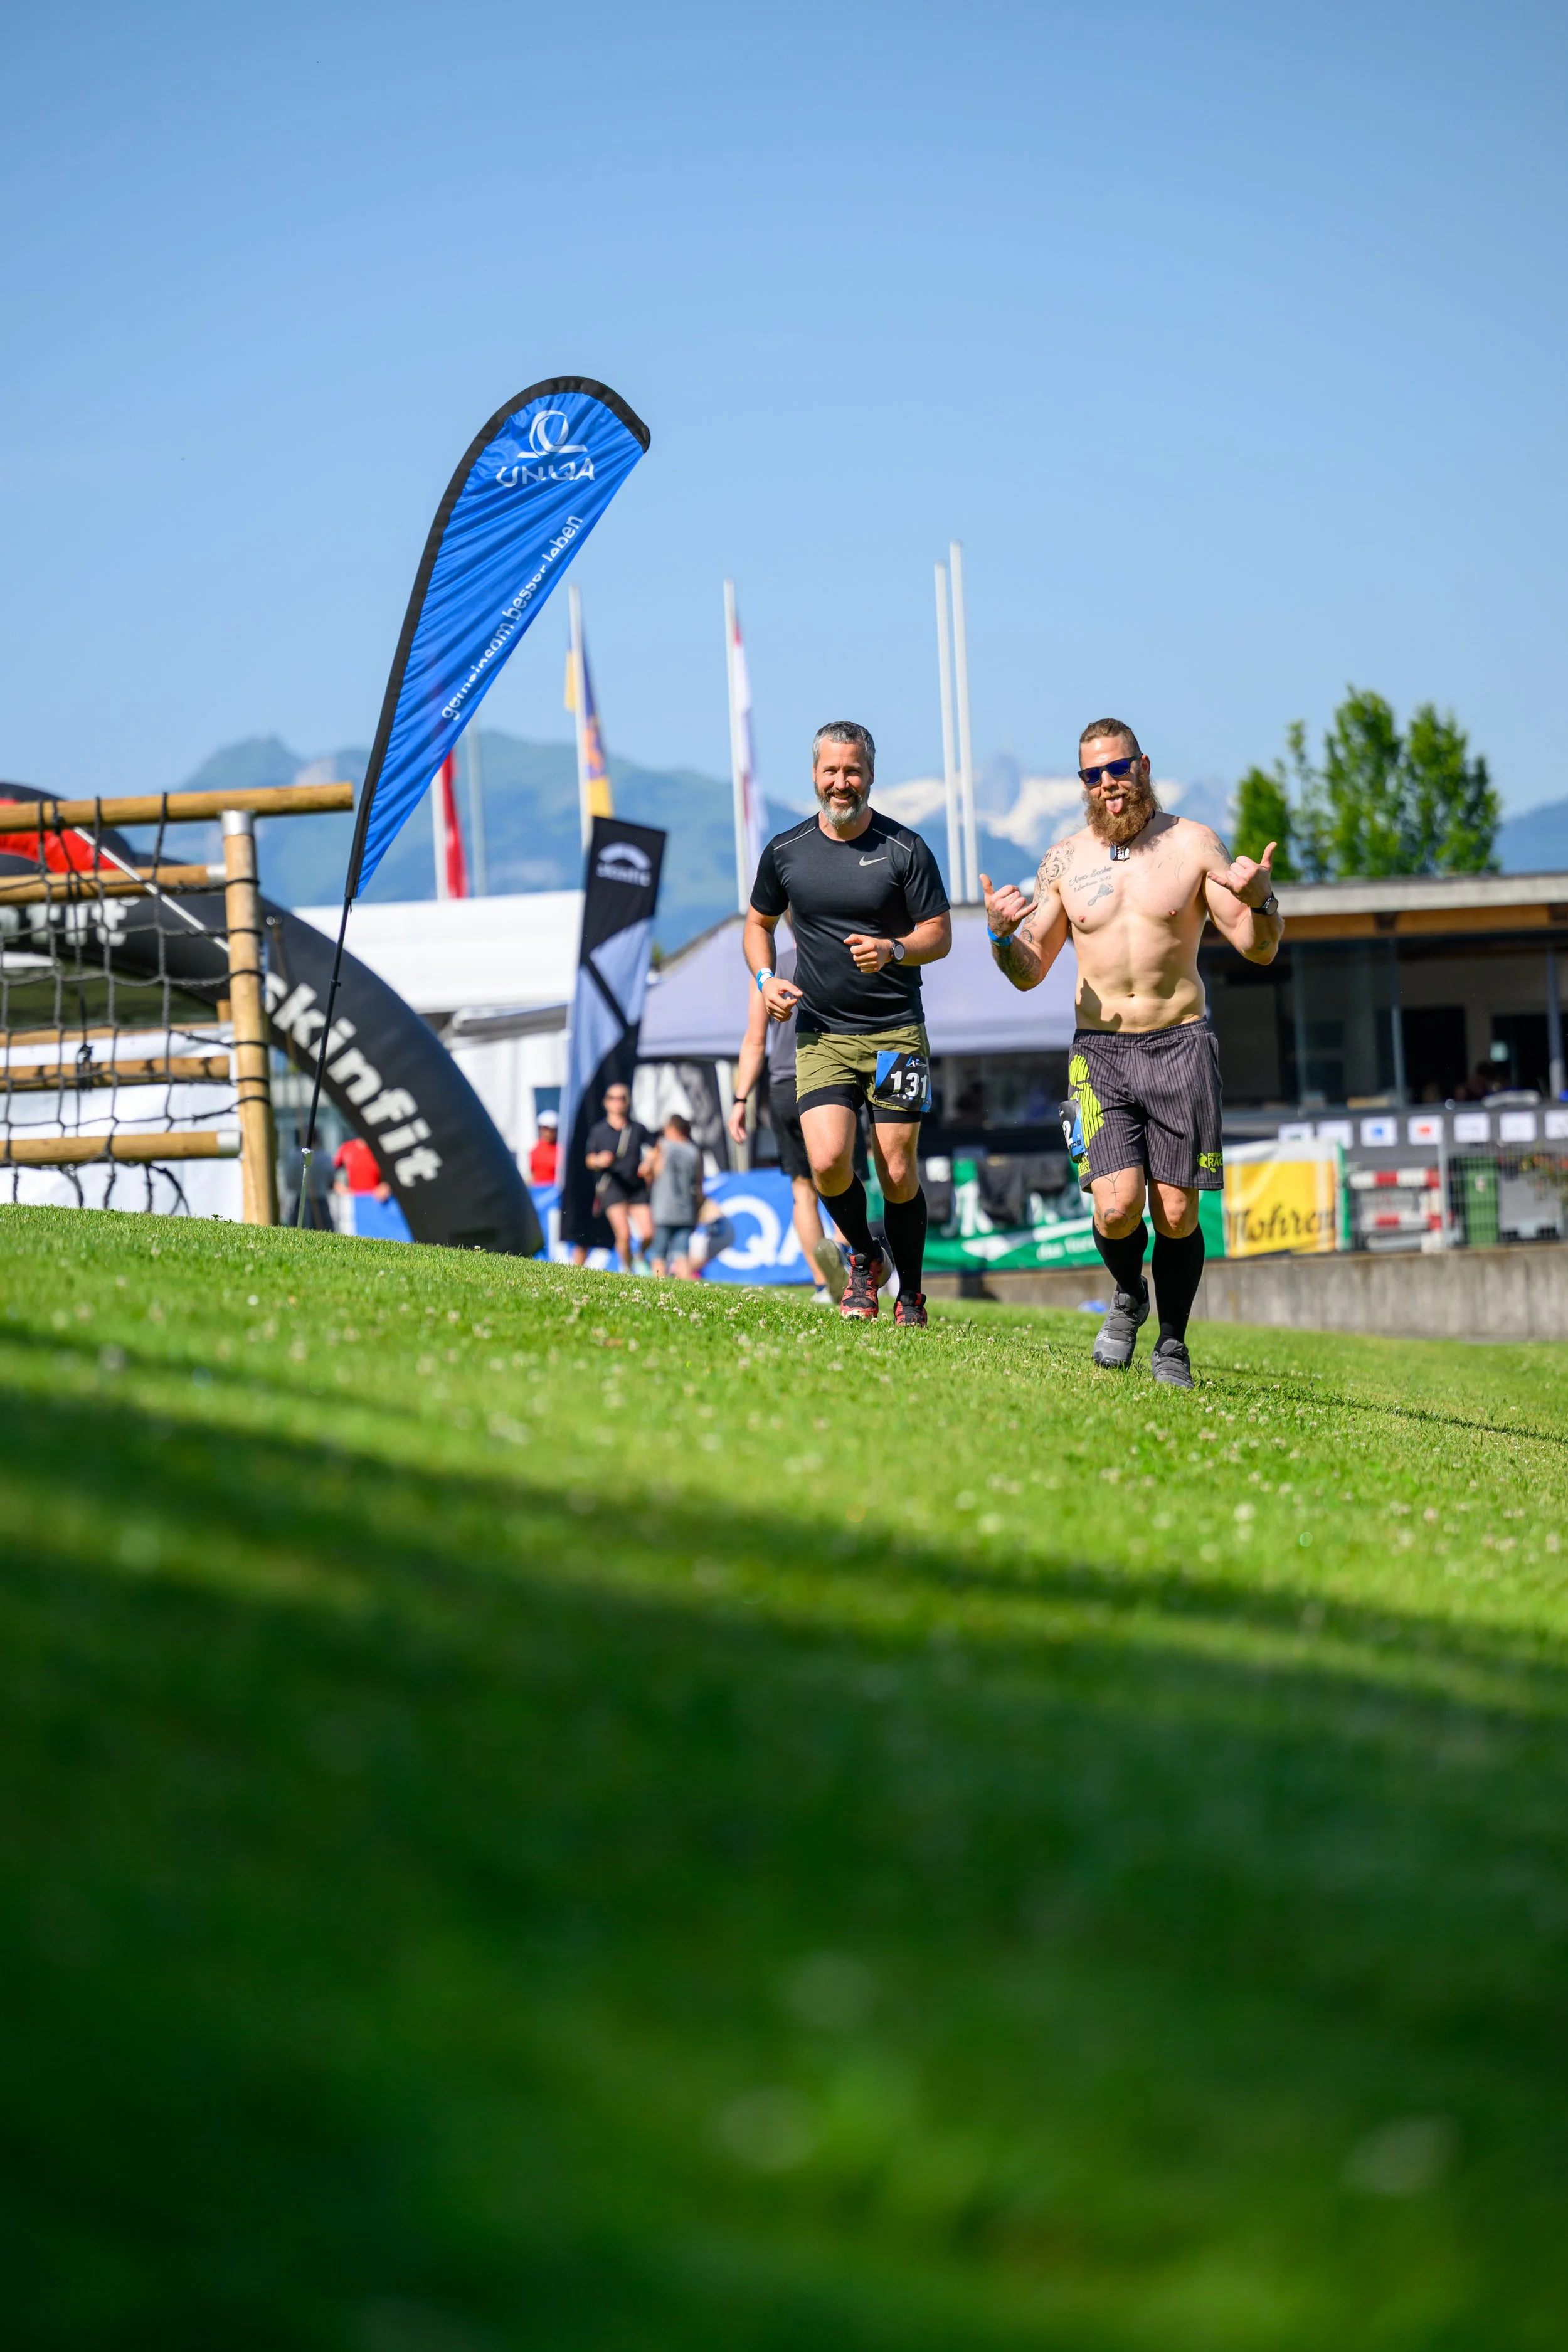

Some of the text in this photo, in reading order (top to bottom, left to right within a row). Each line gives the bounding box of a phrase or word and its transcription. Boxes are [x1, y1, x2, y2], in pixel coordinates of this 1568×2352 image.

[495, 457, 595, 487] UNIQA
[502, 564, 546, 622] besser
[542, 515, 583, 563] leben
[890, 1070, 928, 1099] 131
